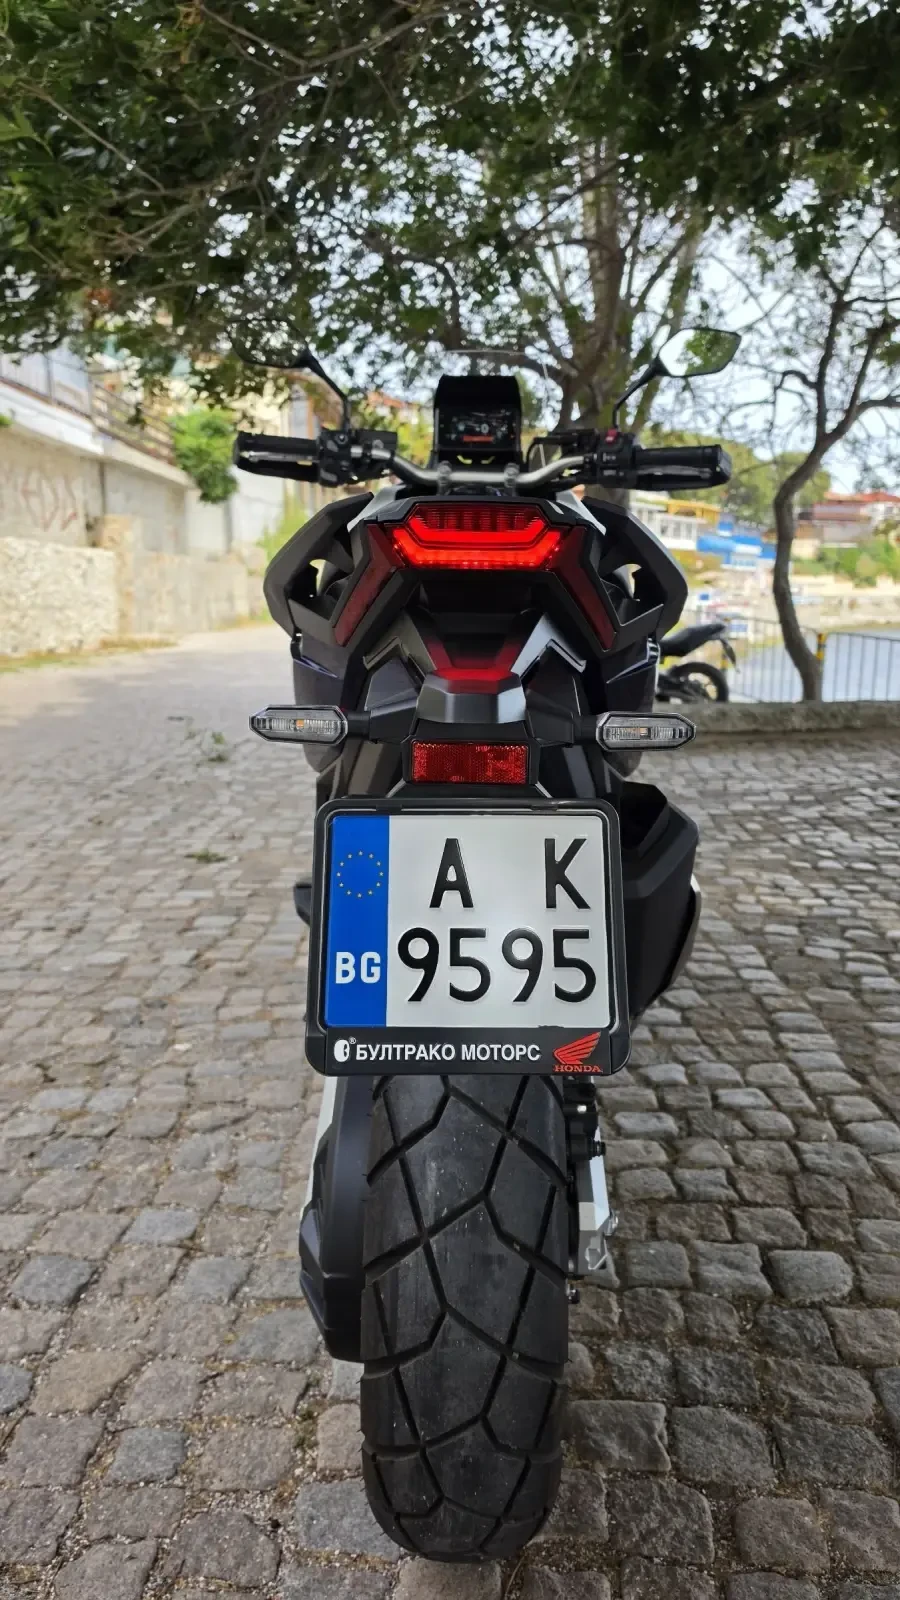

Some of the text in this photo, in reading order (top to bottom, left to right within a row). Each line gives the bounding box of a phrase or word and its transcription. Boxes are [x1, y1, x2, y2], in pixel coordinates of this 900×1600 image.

[429, 837, 591, 910] A K
[335, 951, 381, 984] BG
[397, 927, 597, 1003] 9595
[355, 1043, 541, 1061] БУЛТРАКО МОТОРС
[554, 1065, 601, 1073] HONDA
